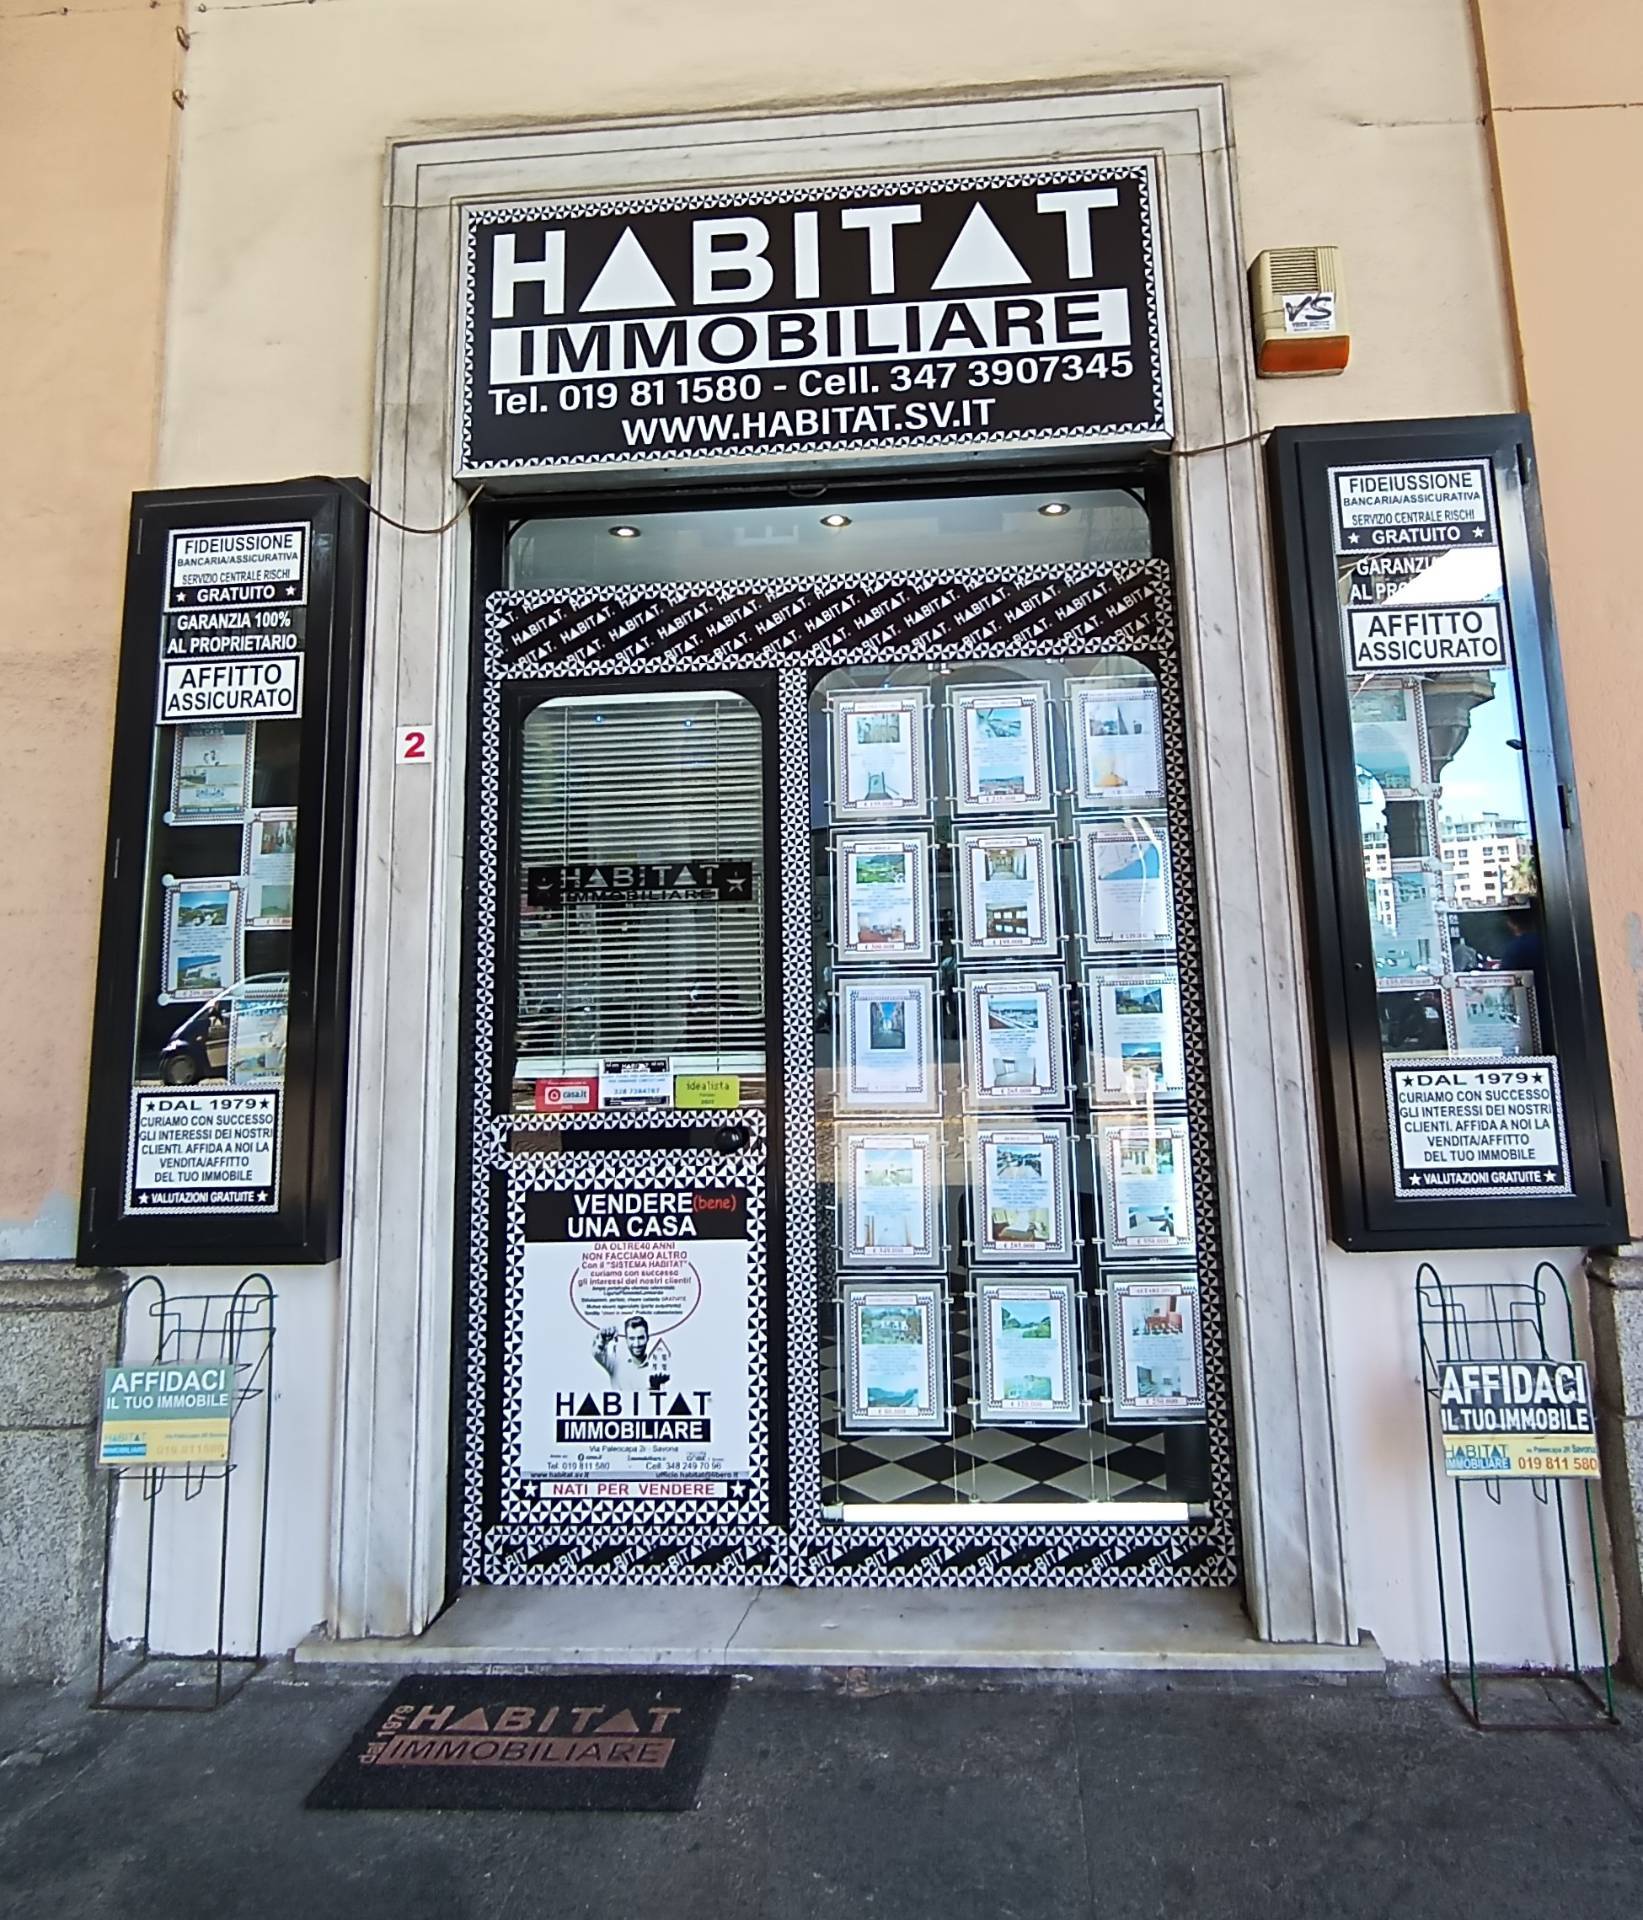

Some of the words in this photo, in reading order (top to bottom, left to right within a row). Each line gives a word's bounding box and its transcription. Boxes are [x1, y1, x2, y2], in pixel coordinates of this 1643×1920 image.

[492, 188, 1119, 319] HABITAT
[519, 293, 1104, 376] IMMOBILIARE
[489, 388, 549, 415] Tel.
[559, 382, 617, 411] 019
[630, 379, 665, 408] 81
[678, 374, 762, 405] 1580
[799, 366, 881, 397] Cell.
[890, 361, 954, 393] 347
[968, 351, 1133, 386] 3907345
[622, 399, 997, 445] WWW.HABITAT.SV.IT
[1350, 472, 1472, 493] FIDEIUSSIONE
[1344, 491, 1481, 507] BANCARIA/ASSICURATIVA
[1352, 513, 1392, 526] SERVIZIO
[1396, 511, 1442, 524] CENTRALE
[1445, 509, 1475, 521] RISCHI
[1372, 526, 1461, 544] GRATUITO
[185, 534, 293, 554] FIDEIUSSIONE
[177, 552, 298, 567] BANCARIA/ASSICURATIVA
[182, 573, 218, 585] SERVIZIO
[220, 571, 261, 583] CENTRALE
[264, 569, 290, 580] RISCHI
[197, 585, 275, 602] GRATUITO
[1350, 584, 1372, 600] AL
[177, 613, 251, 630] GARANZIA
[255, 611, 290, 628] 100%
[1368, 611, 1482, 637] AFFITTO
[167, 638, 186, 653] AL
[190, 634, 297, 652] PROPRIETARIO
[1358, 637, 1497, 661] ASSICURATO
[180, 664, 282, 689] AFFITTO
[168, 688, 292, 711] ASSICURATO
[404, 732, 425, 758] 2
[560, 864, 719, 888] HABITAT
[687, 1081, 729, 1090] idealista
[1418, 1074, 1467, 1086] DAL
[1475, 1072, 1527, 1084] 1979
[1399, 1091, 1453, 1103] CURIAMO
[1457, 1090, 1481, 1102] CON
[1485, 1089, 1549, 1101] SUCCESSO
[159, 1100, 201, 1111] DAL
[210, 1099, 256, 1110] 1979
[1400, 1107, 1419, 1118] GLI
[1422, 1105, 1482, 1117] INTERESSI
[1486, 1105, 1504, 1116] DEI
[1509, 1104, 1552, 1115] NOSTRI
[141, 1116, 188, 1127] CURIAMO
[191, 1115, 213, 1126] CON
[217, 1114, 273, 1125] SUCCESSO
[1455, 1120, 1497, 1131] AFFIDA
[1500, 1119, 1511, 1130] A
[1511, 1119, 1532, 1129] NOI
[1535, 1118, 1550, 1129] LA
[139, 1130, 156, 1141] GLI
[159, 1129, 212, 1140] INTERESSI
[215, 1129, 231, 1139] DEI
[234, 1128, 272, 1138] NOSTRI
[1427, 1134, 1529, 1147] VENDITA/AFFITTO
[186, 1143, 222, 1153] AFFIDA
[225, 1143, 233, 1152] A
[235, 1142, 253, 1152] NOI
[256, 1142, 269, 1151] LA
[1424, 1150, 1446, 1162] DEL
[1451, 1150, 1474, 1161] TUO
[1478, 1149, 1536, 1160] IMMOBILE
[160, 1156, 249, 1168] VENDITA/AFFITTO
[154, 1172, 174, 1182] DEL
[178, 1171, 198, 1182] TUO
[202, 1170, 252, 1181] IMMOBILE
[1423, 1171, 1489, 1185] VALUTAZIONI
[1491, 1170, 1542, 1183] GRATUITE
[151, 1191, 208, 1204] VALUTAZIONI
[210, 1191, 254, 1202] GRATUITE
[574, 1193, 693, 1215] VENDERE
[693, 1194, 736, 1212] (bene)
[567, 1217, 620, 1238] UNA
[627, 1216, 697, 1236] CASA
[582, 1252, 602, 1260] NON
[605, 1252, 654, 1260] FACCIAMO
[656, 1251, 687, 1259] ALTRO
[594, 1243, 608, 1251] DA
[589, 1277, 623, 1285] interessi
[111, 1370, 225, 1393] AFFIDACI
[1441, 1365, 1587, 1405] AFFIDACI
[107, 1398, 119, 1409] IL
[124, 1396, 153, 1408] TUO
[158, 1394, 228, 1408] IMMOBILE
[556, 1391, 711, 1416] HABITAT
[1442, 1409, 1459, 1431] IL
[1461, 1408, 1496, 1431] TUO
[1499, 1408, 1590, 1431] IMMOBILE
[564, 1421, 703, 1440] IMMOBILIARE
[1518, 1457, 1542, 1470] 019
[1545, 1457, 1568, 1470] 811
[1574, 1457, 1596, 1470] 580
[553, 1483, 588, 1495] NATI
[597, 1483, 629, 1495] PER
[639, 1483, 715, 1495] VENDERE
[407, 1705, 682, 1734] HABITAT
[389, 1740, 663, 1764] IMMOBILIARE
